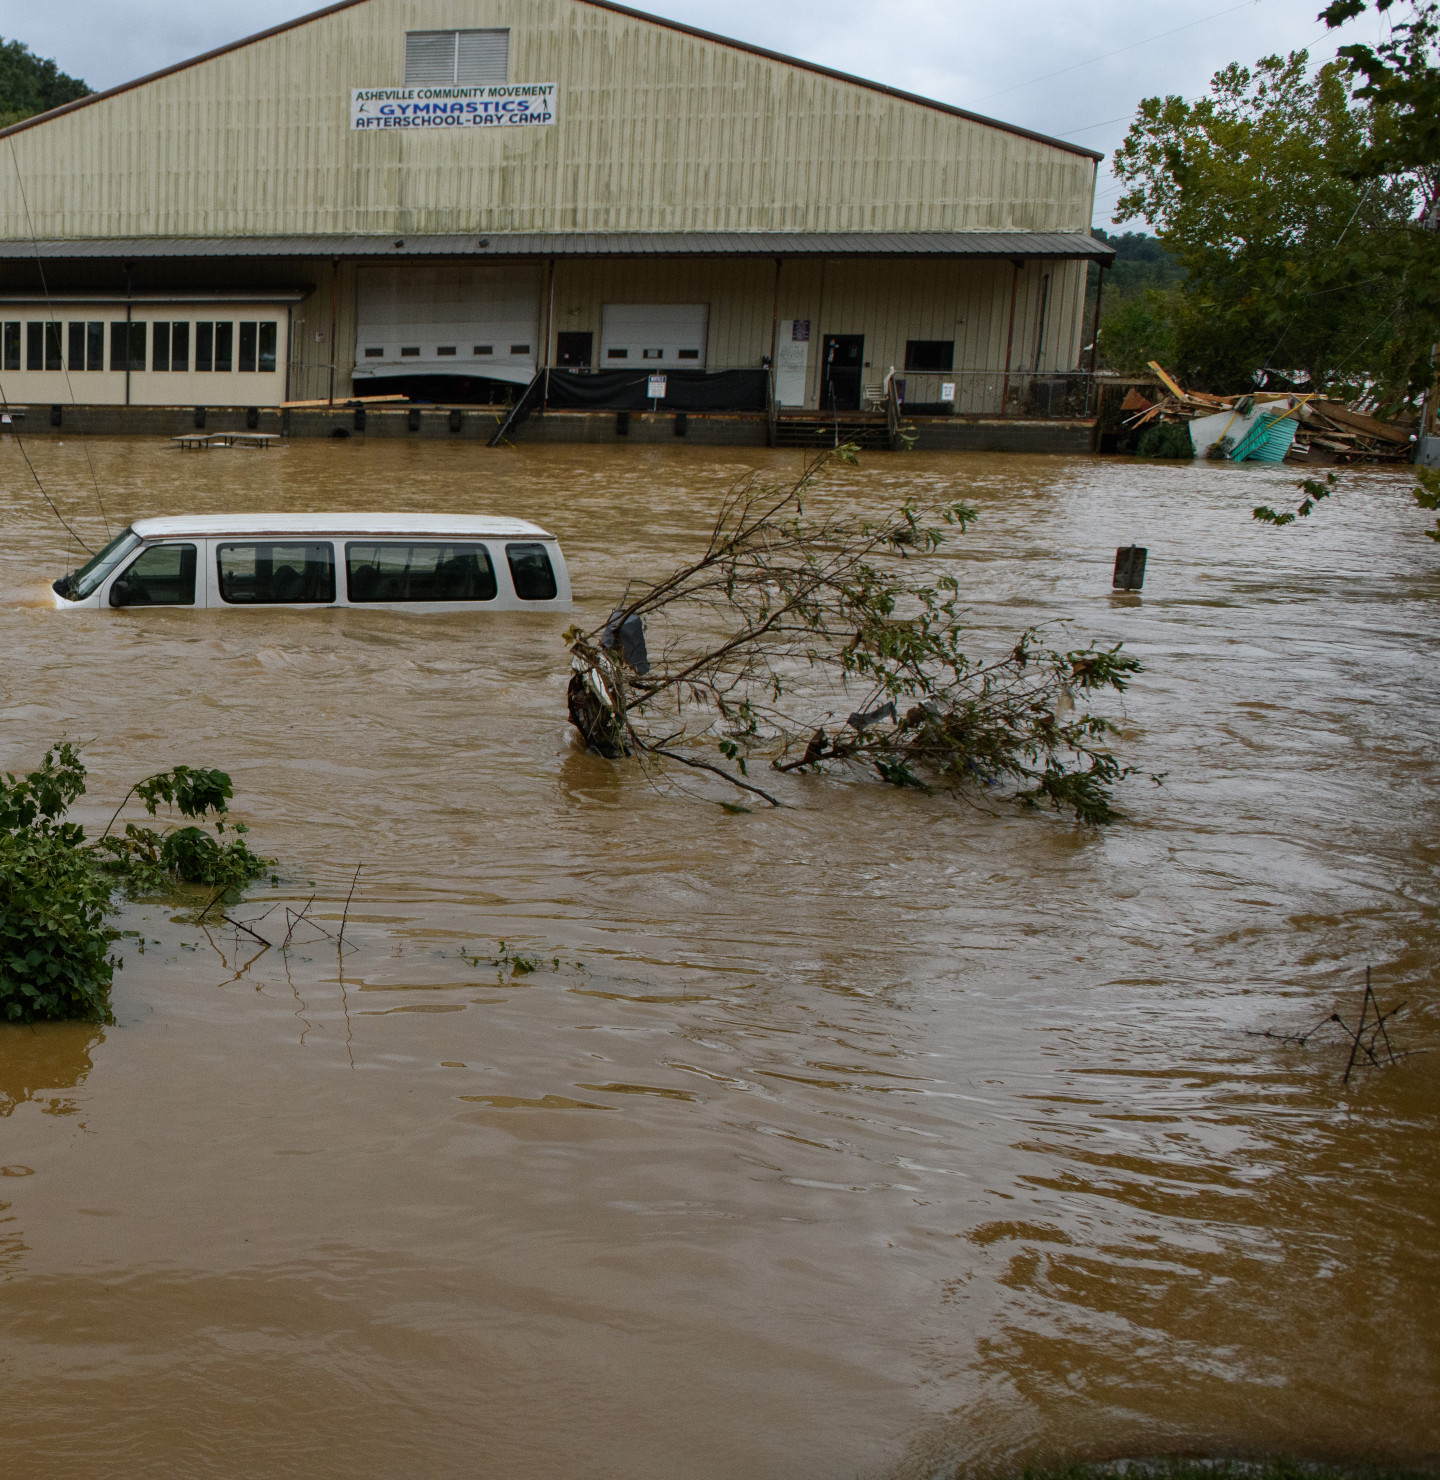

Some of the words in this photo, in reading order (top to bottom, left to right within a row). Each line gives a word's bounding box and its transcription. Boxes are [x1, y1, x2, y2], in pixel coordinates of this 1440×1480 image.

[356, 90, 414, 101] ASHEVILLE
[417, 87, 485, 99] COMMUNITY
[488, 85, 554, 97] MOVEMENT
[380, 101, 529, 115] GYMNASTICS
[356, 114, 504, 127] AFTERSCHOOL-DAY
[509, 112, 552, 124] CAMP
